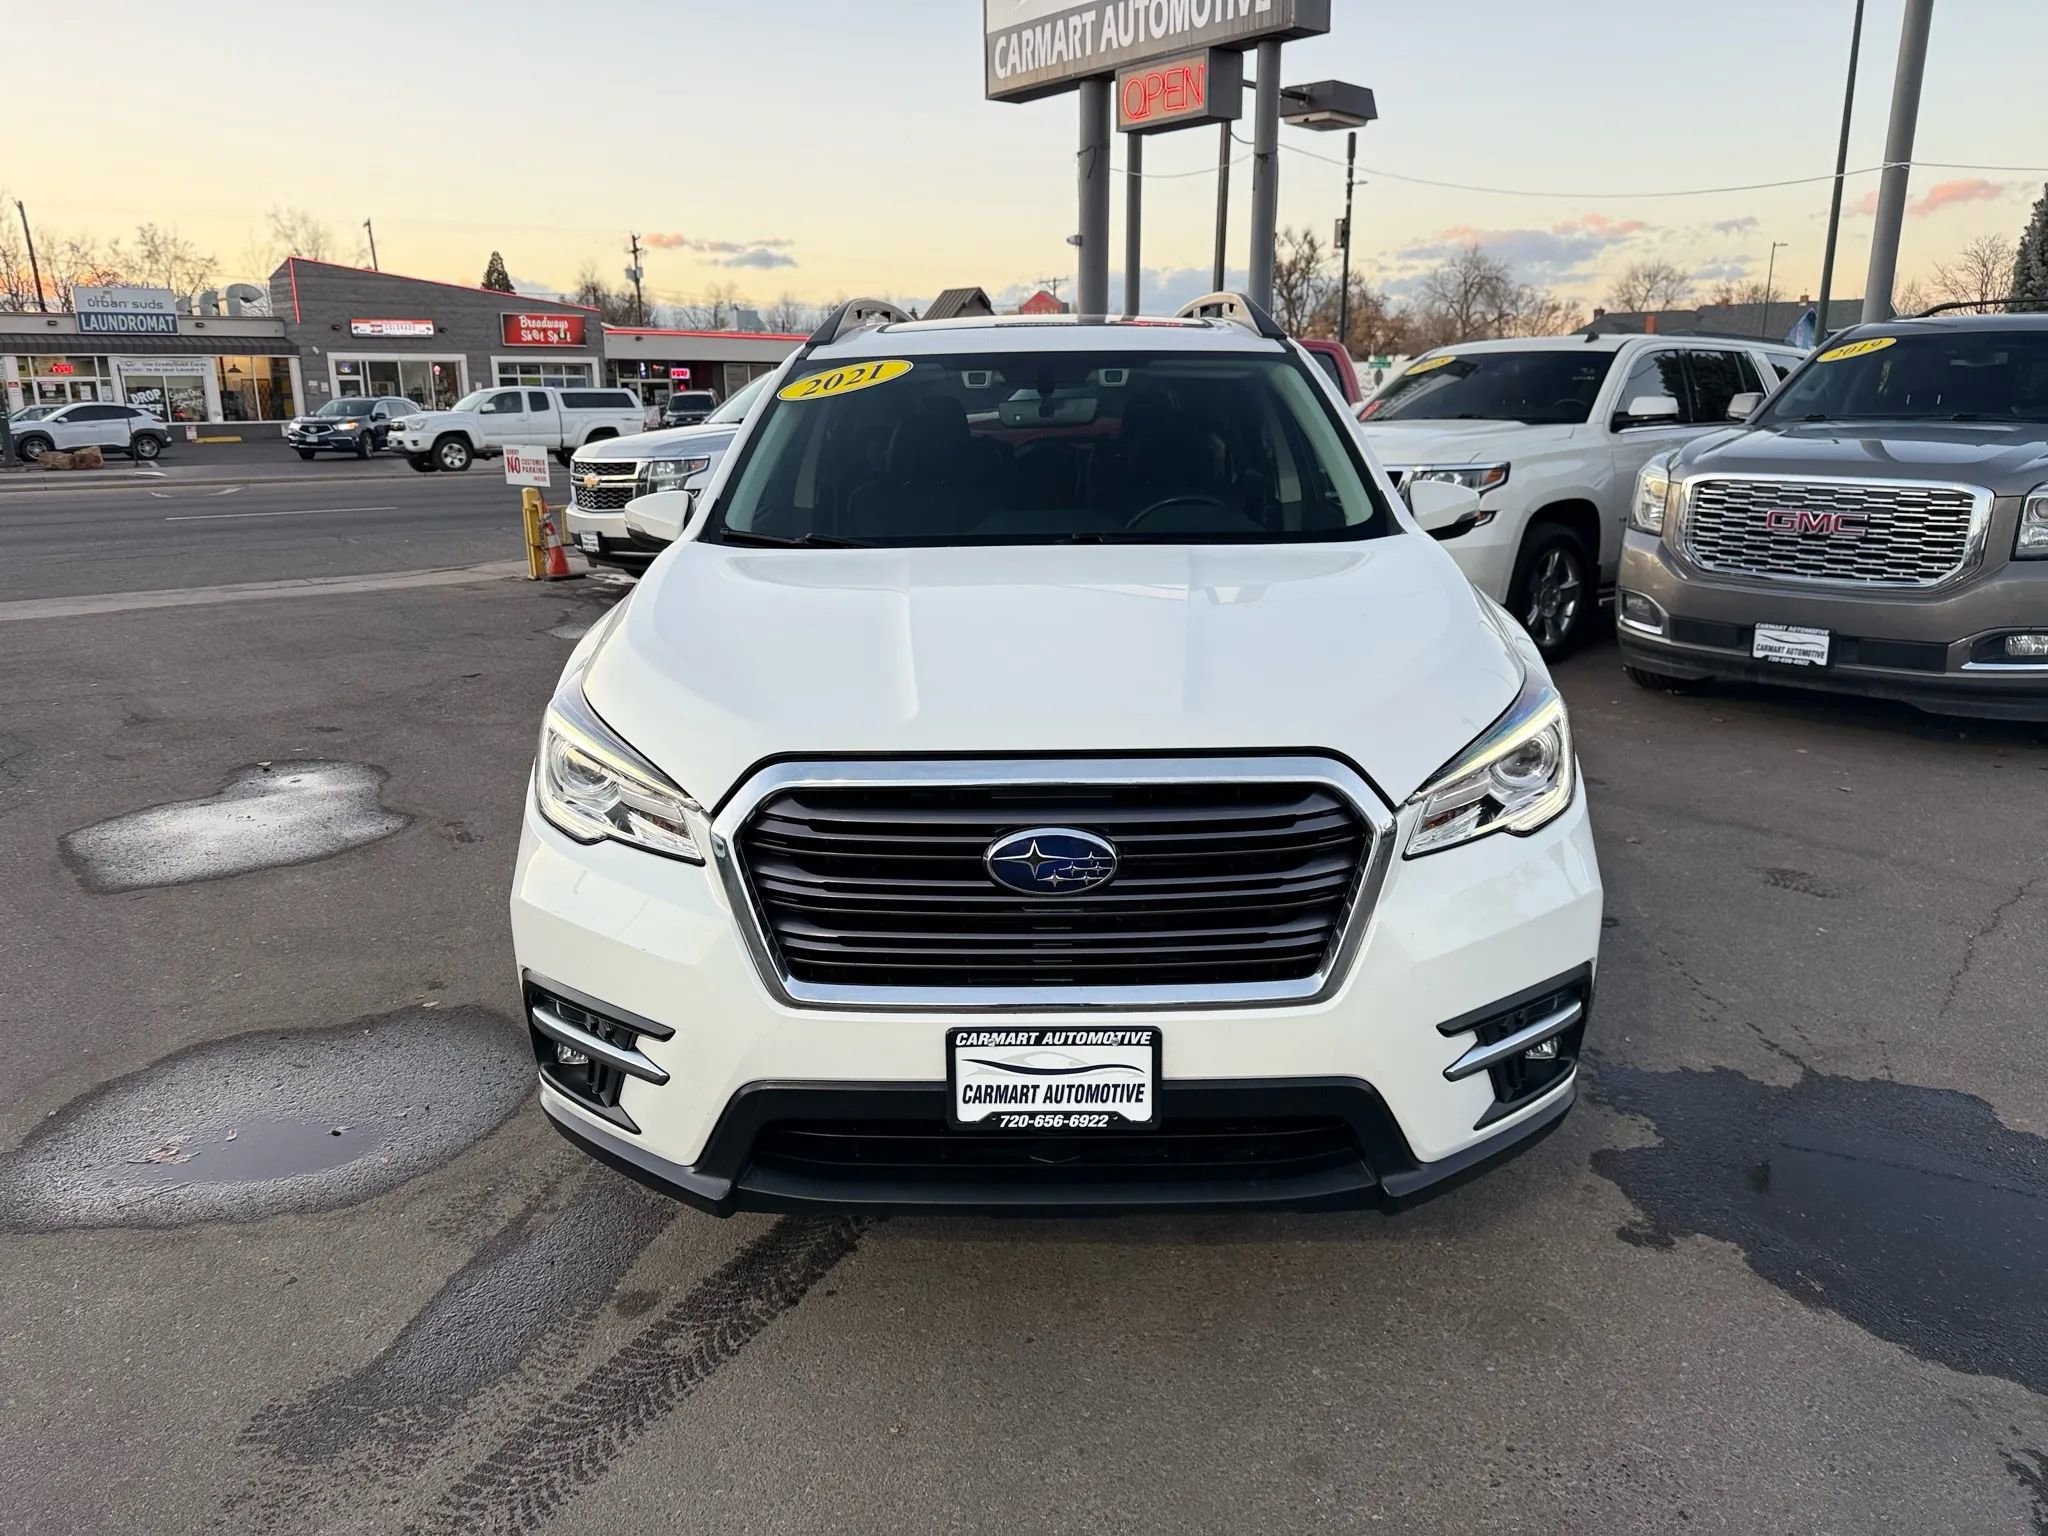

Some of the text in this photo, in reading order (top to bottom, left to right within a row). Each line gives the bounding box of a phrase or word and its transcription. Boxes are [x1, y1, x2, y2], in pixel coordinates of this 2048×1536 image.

[994, 0, 1271, 79] CARMART AUTOMO
[1123, 64, 1205, 121] OPEN
[87, 295, 164, 309] urban suds
[80, 314, 174, 332] LAUNDROMAT
[518, 315, 569, 331] Broadways
[800, 364, 884, 397] 2021
[130, 388, 161, 405] DROP
[506, 456, 521, 474] NO
[521, 458, 545, 466] CUSTOMER
[522, 466, 546, 474] PARKING
[1765, 509, 1870, 536] GMC
[1756, 643, 1825, 659] CARMART AUTOMOTIVE
[955, 1031, 1152, 1047] CARMART AUTOMOTIVE
[962, 1083, 1146, 1104] CARMART AUTOMOTIVE
[999, 1114, 1109, 1128] 720-656-6922
